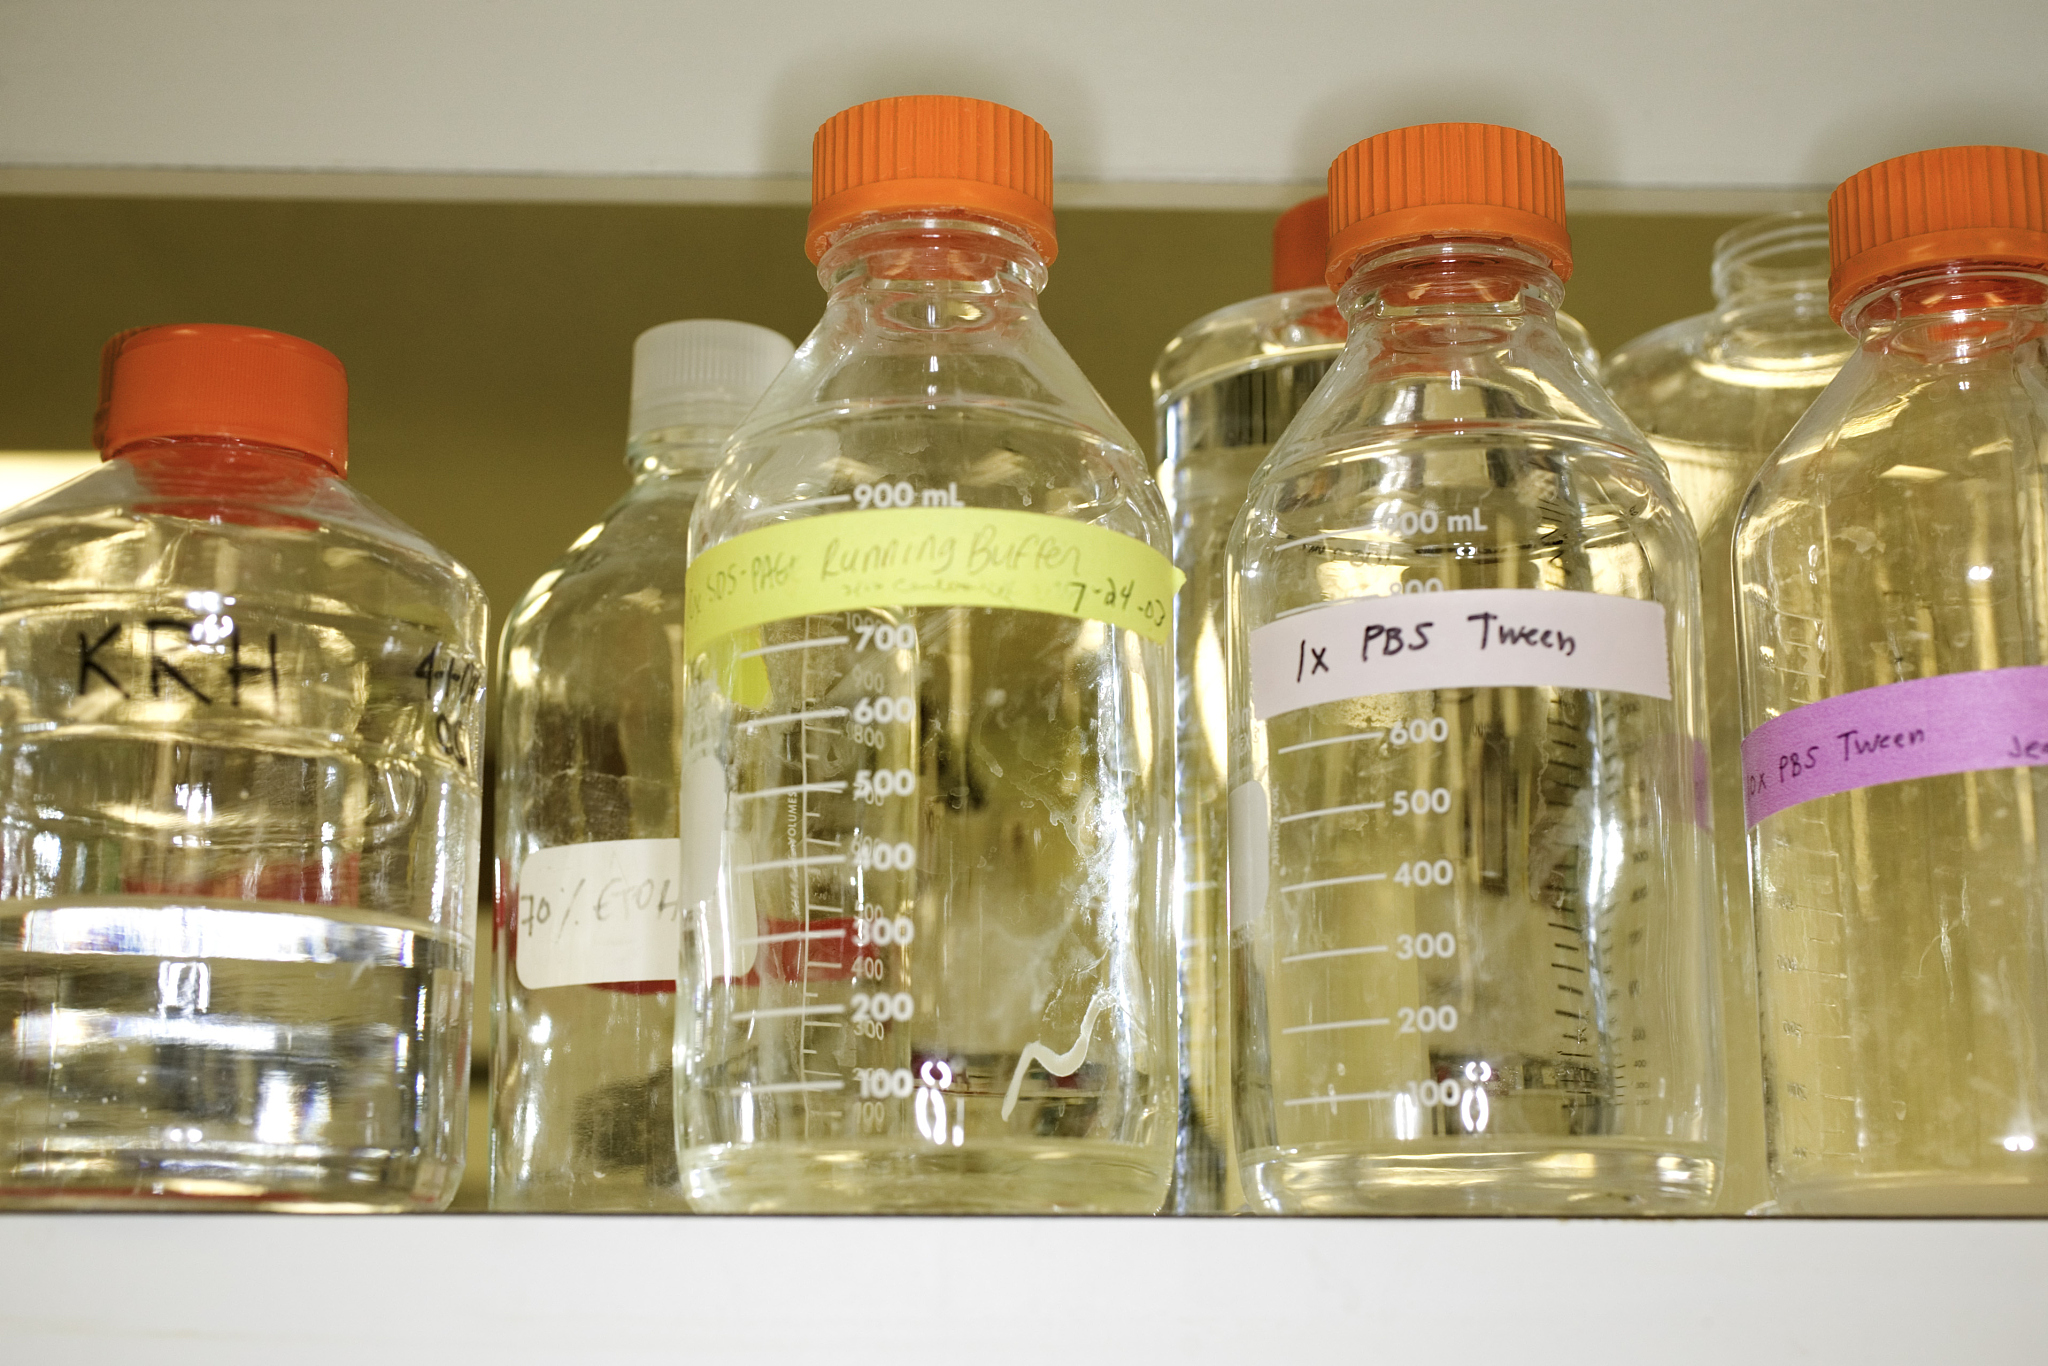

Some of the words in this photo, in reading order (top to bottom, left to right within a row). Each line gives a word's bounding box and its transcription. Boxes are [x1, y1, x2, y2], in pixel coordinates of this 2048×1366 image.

[853, 482, 915, 509] 900
[922, 481, 965, 507] mL
[1447, 507, 1488, 533] mL
[855, 623, 916, 652] 700
[1362, 622, 1434, 662] PBS
[1467, 612, 1576, 656] Tween
[854, 696, 916, 725] 600
[1389, 717, 1449, 745] 600
[1779, 746, 1819, 783] PBS
[1837, 728, 1925, 761] Tween
[854, 768, 916, 797] 500
[1392, 788, 1451, 816] 500
[1393, 859, 1454, 887] 400
[851, 916, 915, 947] 300
[1396, 932, 1456, 960] 300
[851, 992, 915, 1022] 200
[1398, 1005, 1458, 1034] 200
[859, 1068, 914, 1099] 100
[1406, 1078, 1461, 1107] 100
